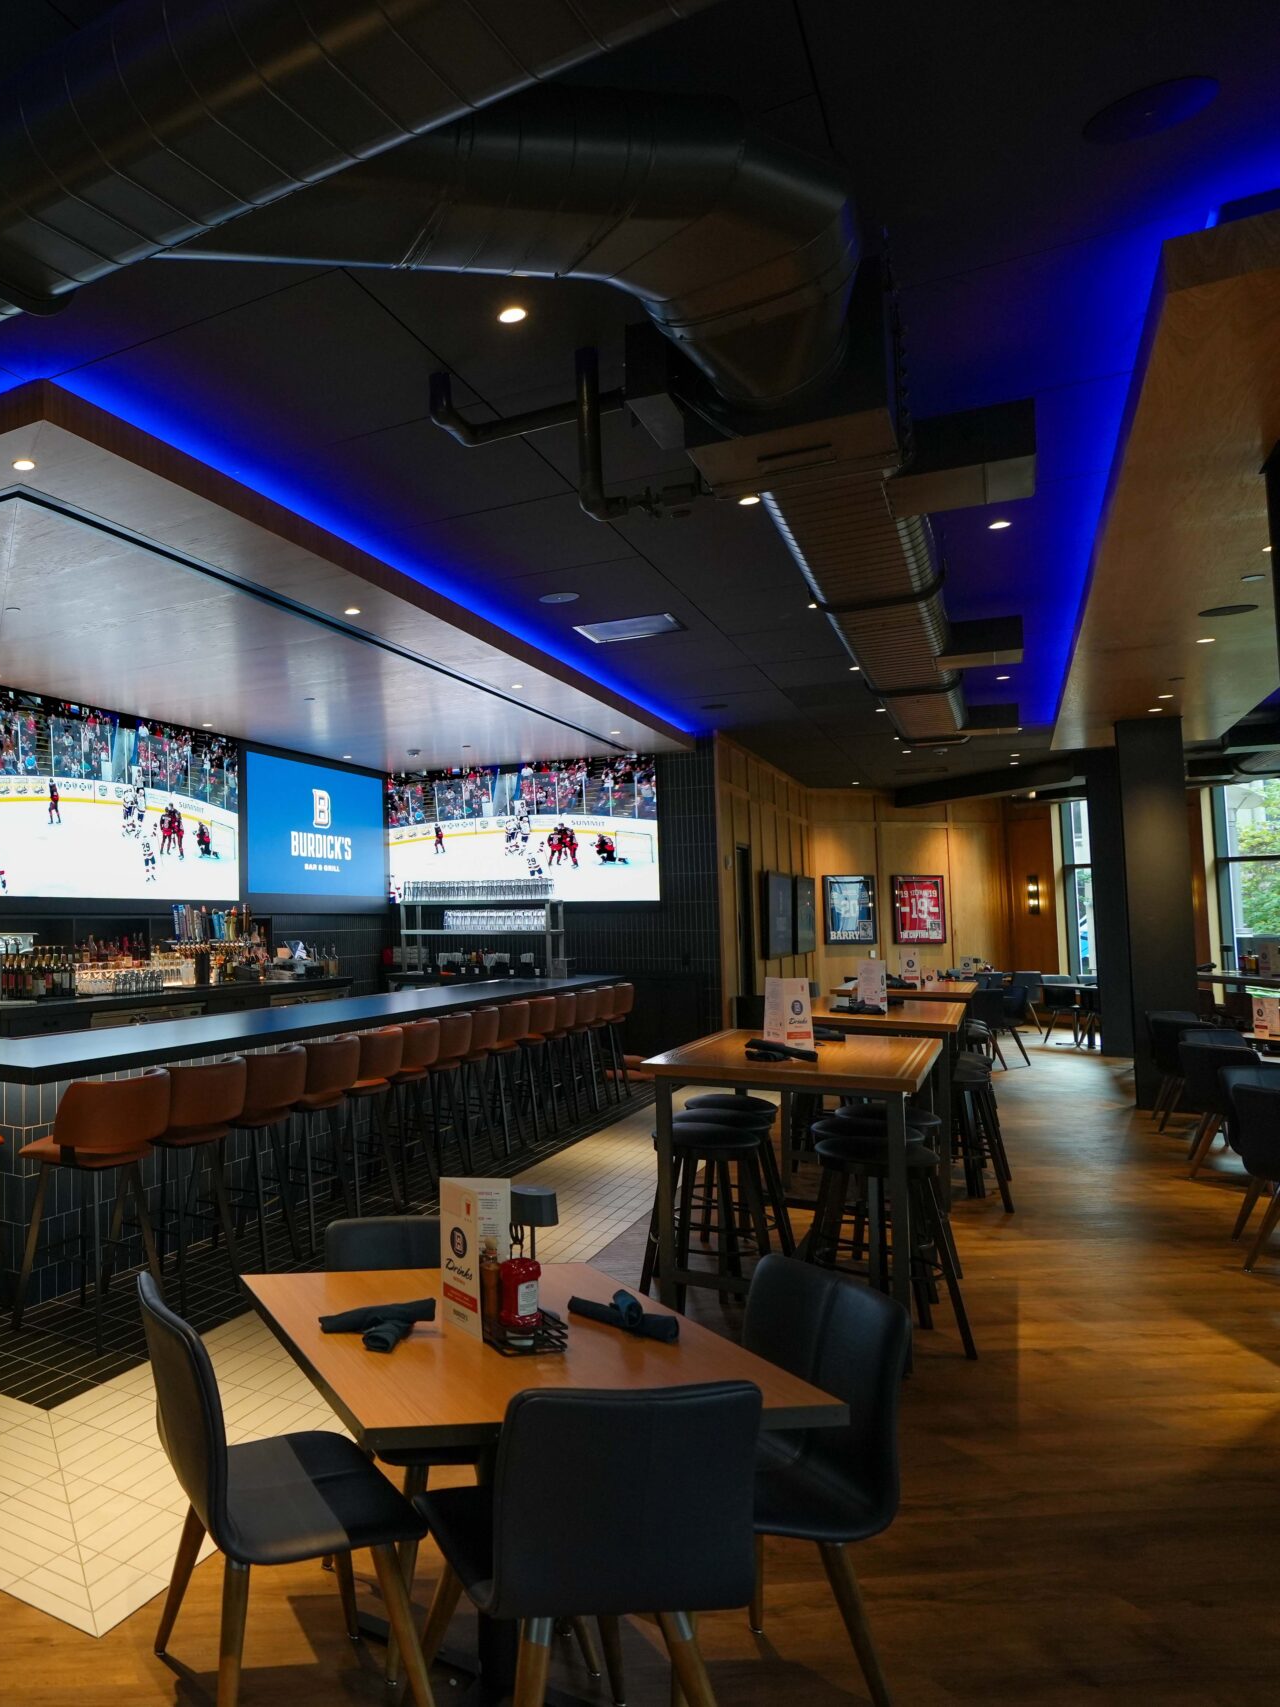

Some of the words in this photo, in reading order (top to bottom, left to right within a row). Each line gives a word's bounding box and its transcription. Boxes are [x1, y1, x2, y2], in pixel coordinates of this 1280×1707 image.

[290, 830, 352, 861] BURDICK'S
[841, 900, 859, 917] 20
[911, 898, 928, 918] 19
[830, 931, 860, 940] BARRY
[445, 1258, 473, 1281] Drinks
